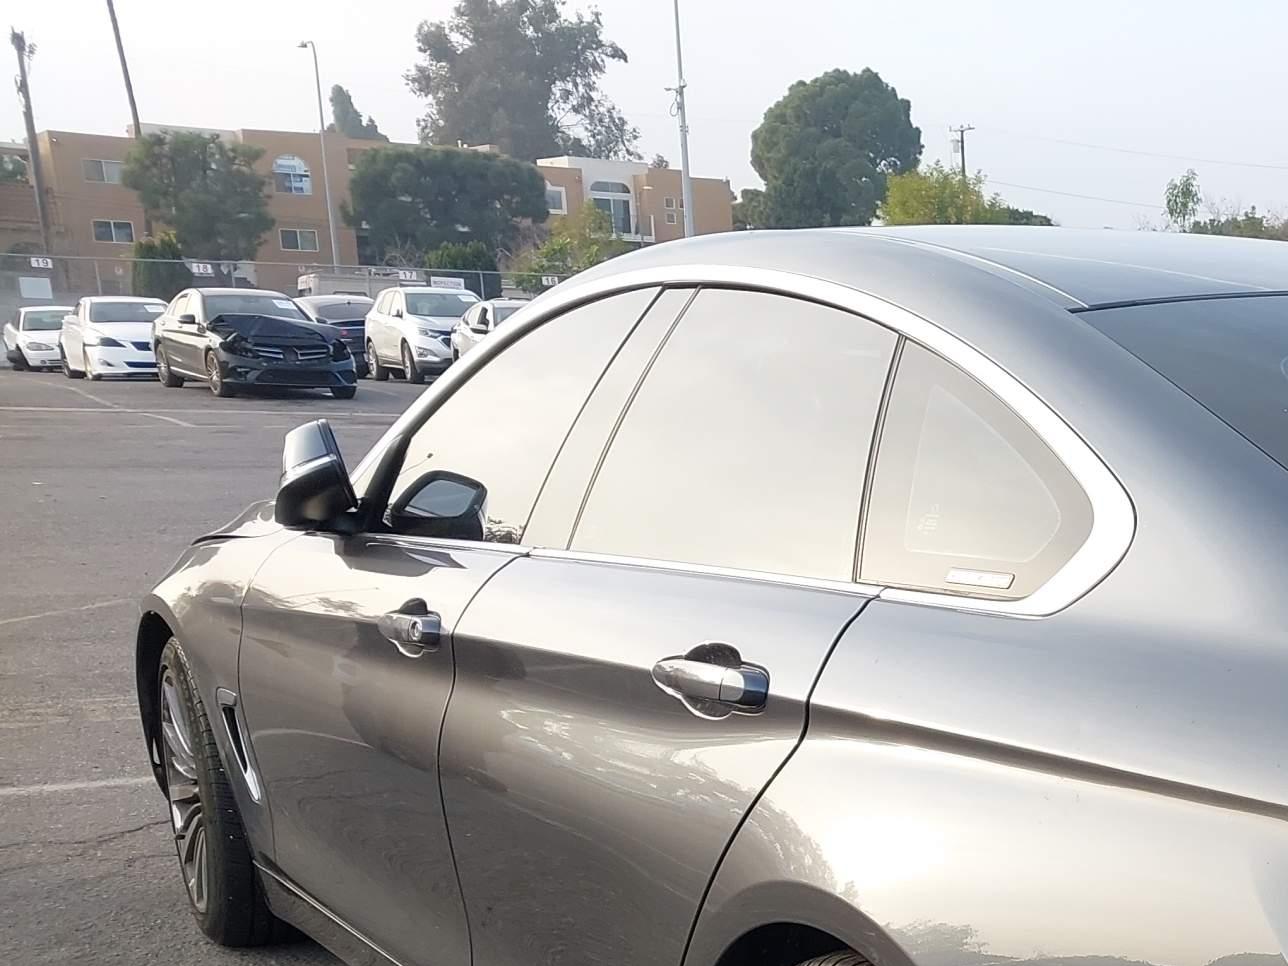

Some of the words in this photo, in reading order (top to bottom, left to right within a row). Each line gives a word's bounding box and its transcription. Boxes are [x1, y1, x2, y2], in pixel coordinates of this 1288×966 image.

[35, 258, 49, 267] 19
[197, 264, 208, 273] 18
[402, 271, 414, 279] 17
[544, 277, 556, 285] 16
